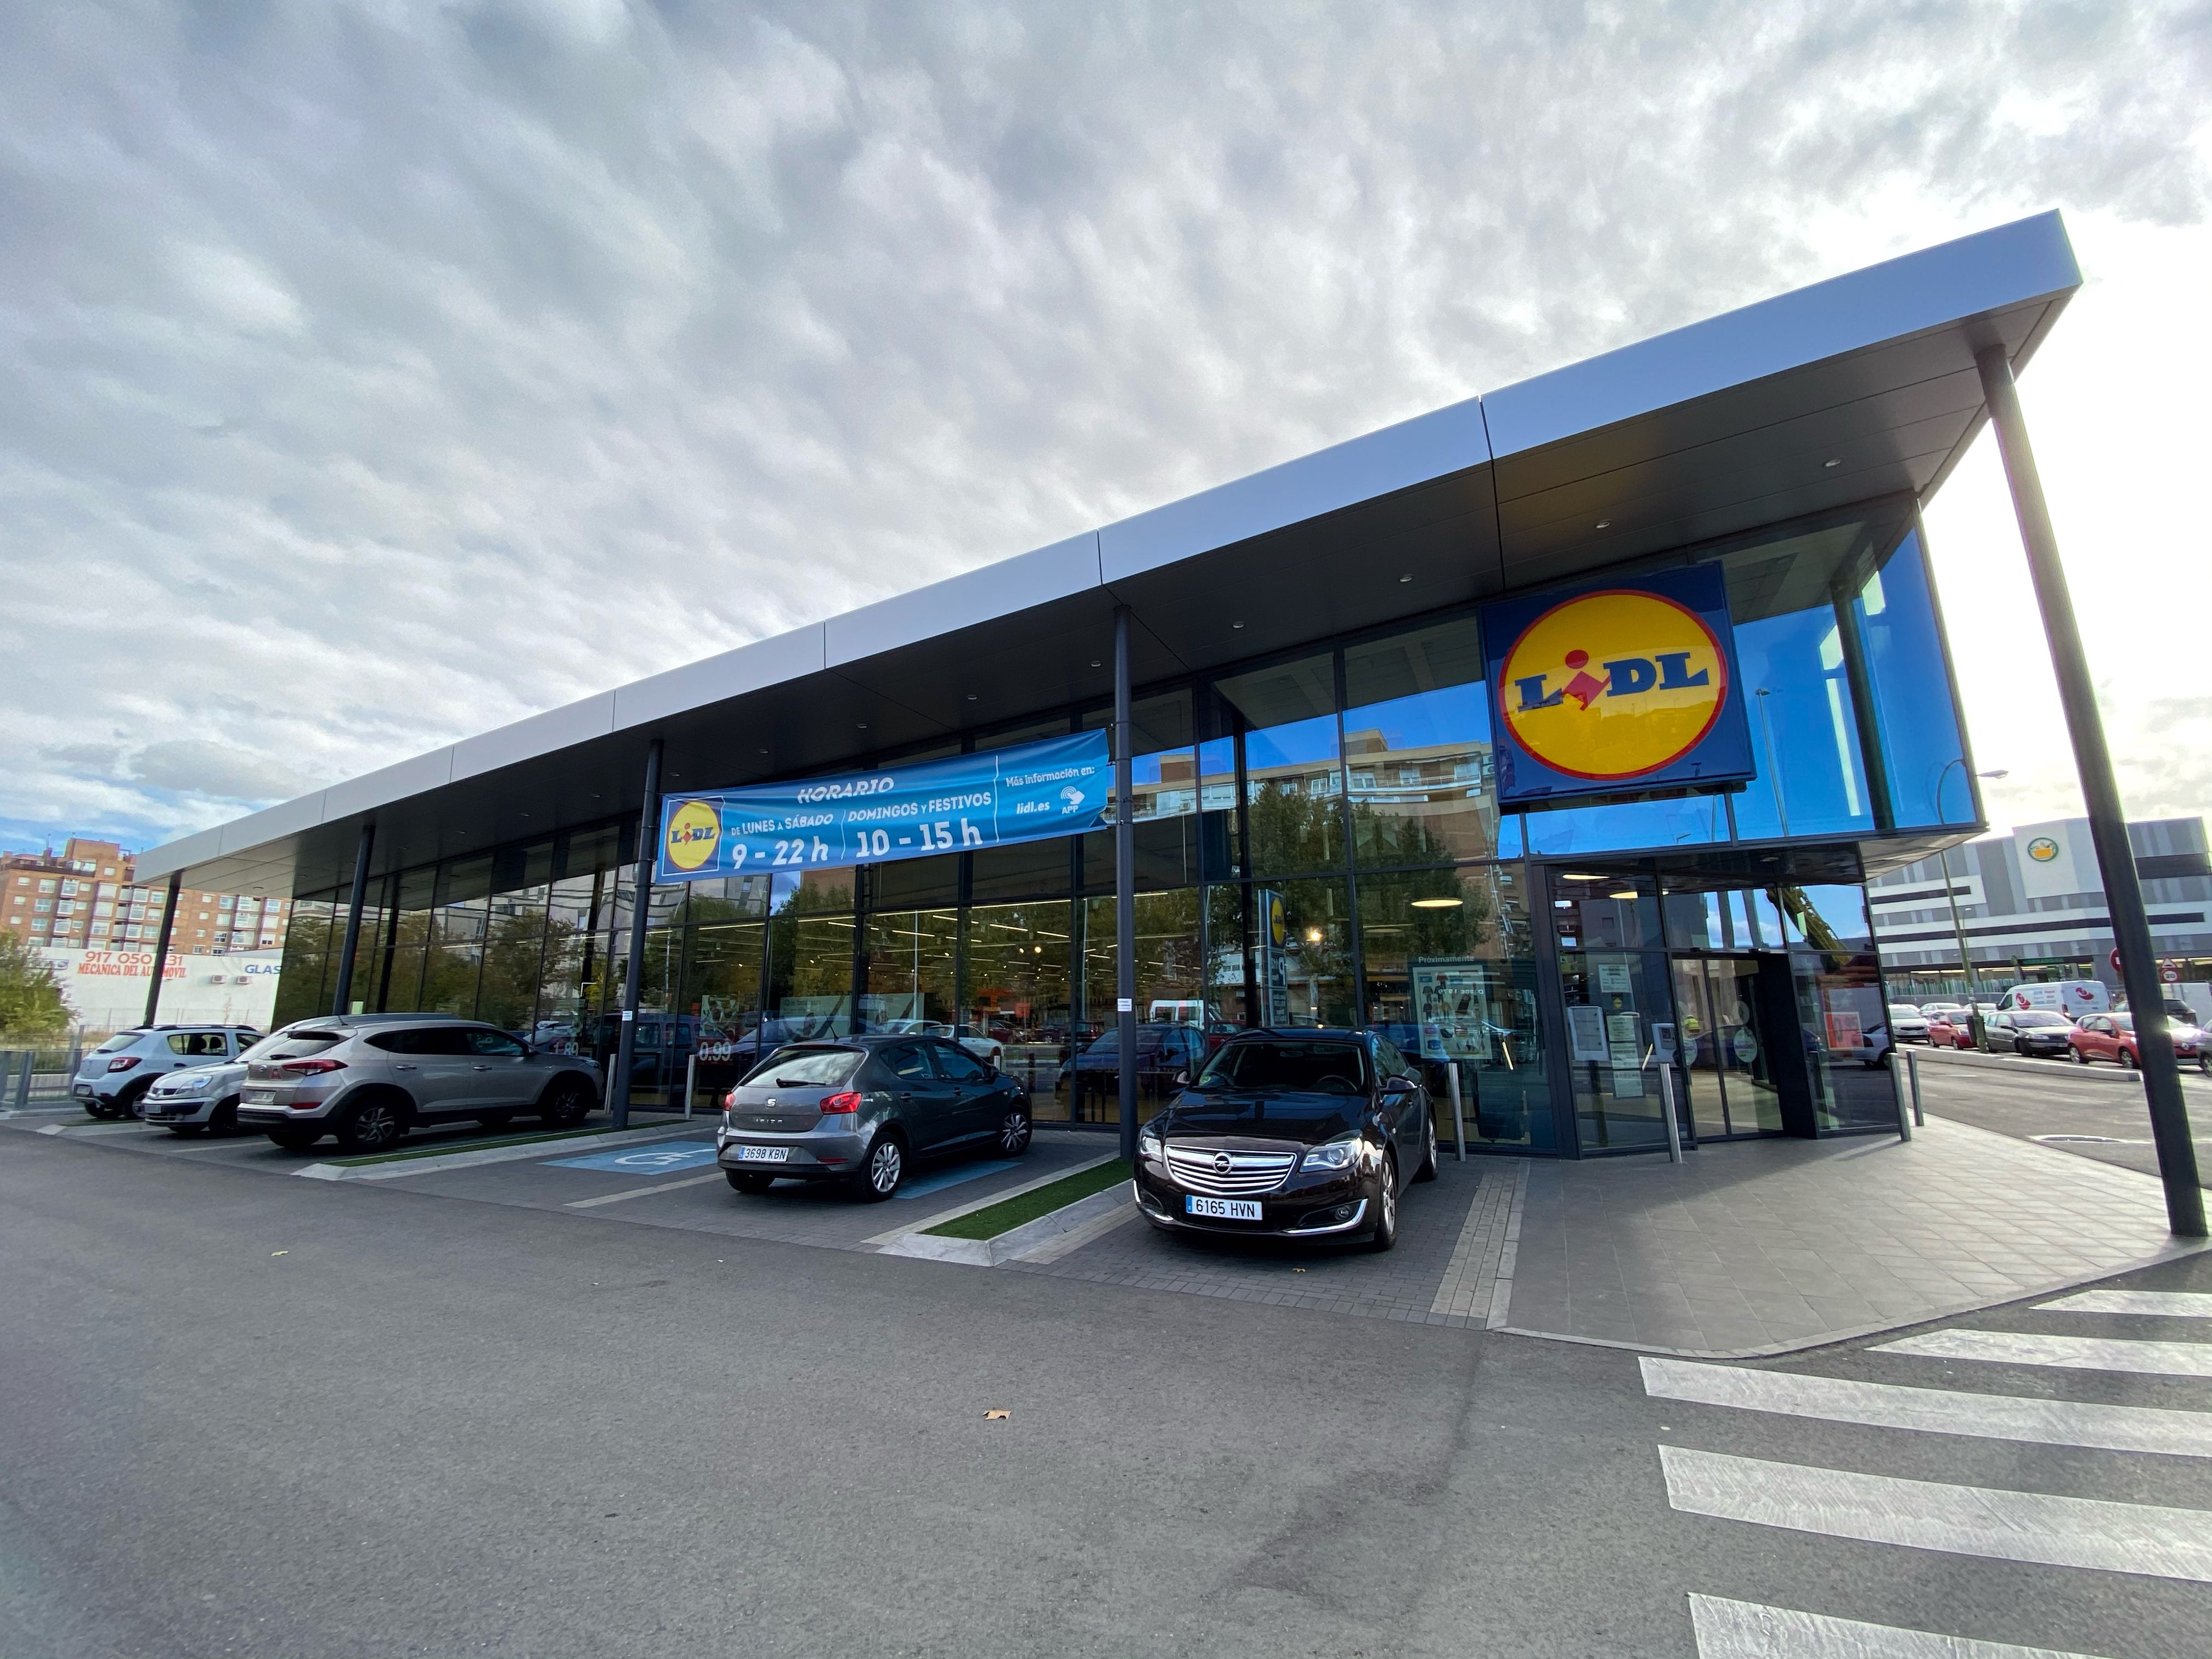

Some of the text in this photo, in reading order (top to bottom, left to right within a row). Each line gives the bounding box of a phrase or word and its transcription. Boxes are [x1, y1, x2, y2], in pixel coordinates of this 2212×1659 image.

[1006, 766, 1095, 787] Más información en:
[797, 777, 895, 804] HORARIO
[848, 792, 992, 822] DOMINGOS Y FESTIVOS
[1017, 801, 1050, 814] lidl.es
[1062, 805, 1079, 815] APP
[731, 827, 741, 836] DE
[742, 820, 775, 834] LUNES
[785, 813, 834, 830] SÁBADO
[856, 829, 890, 858] 10
[919, 821, 953, 851] 15
[961, 817, 983, 847] h
[732, 843, 747, 870] 9
[772, 838, 805, 866] 22
[811, 836, 829, 862] h
[85, 951, 183, 966] 917 050 31
[1418, 955, 1475, 964] Próximamente
[78, 963, 187, 978] MECANICA DEL AUMOVIL
[554, 1042, 579, 1056] 189
[699, 1042, 731, 1061] 0.99
[745, 1148, 787, 1159] 3698 KBN
[1197, 1199, 1255, 1217] 6165 HVN
